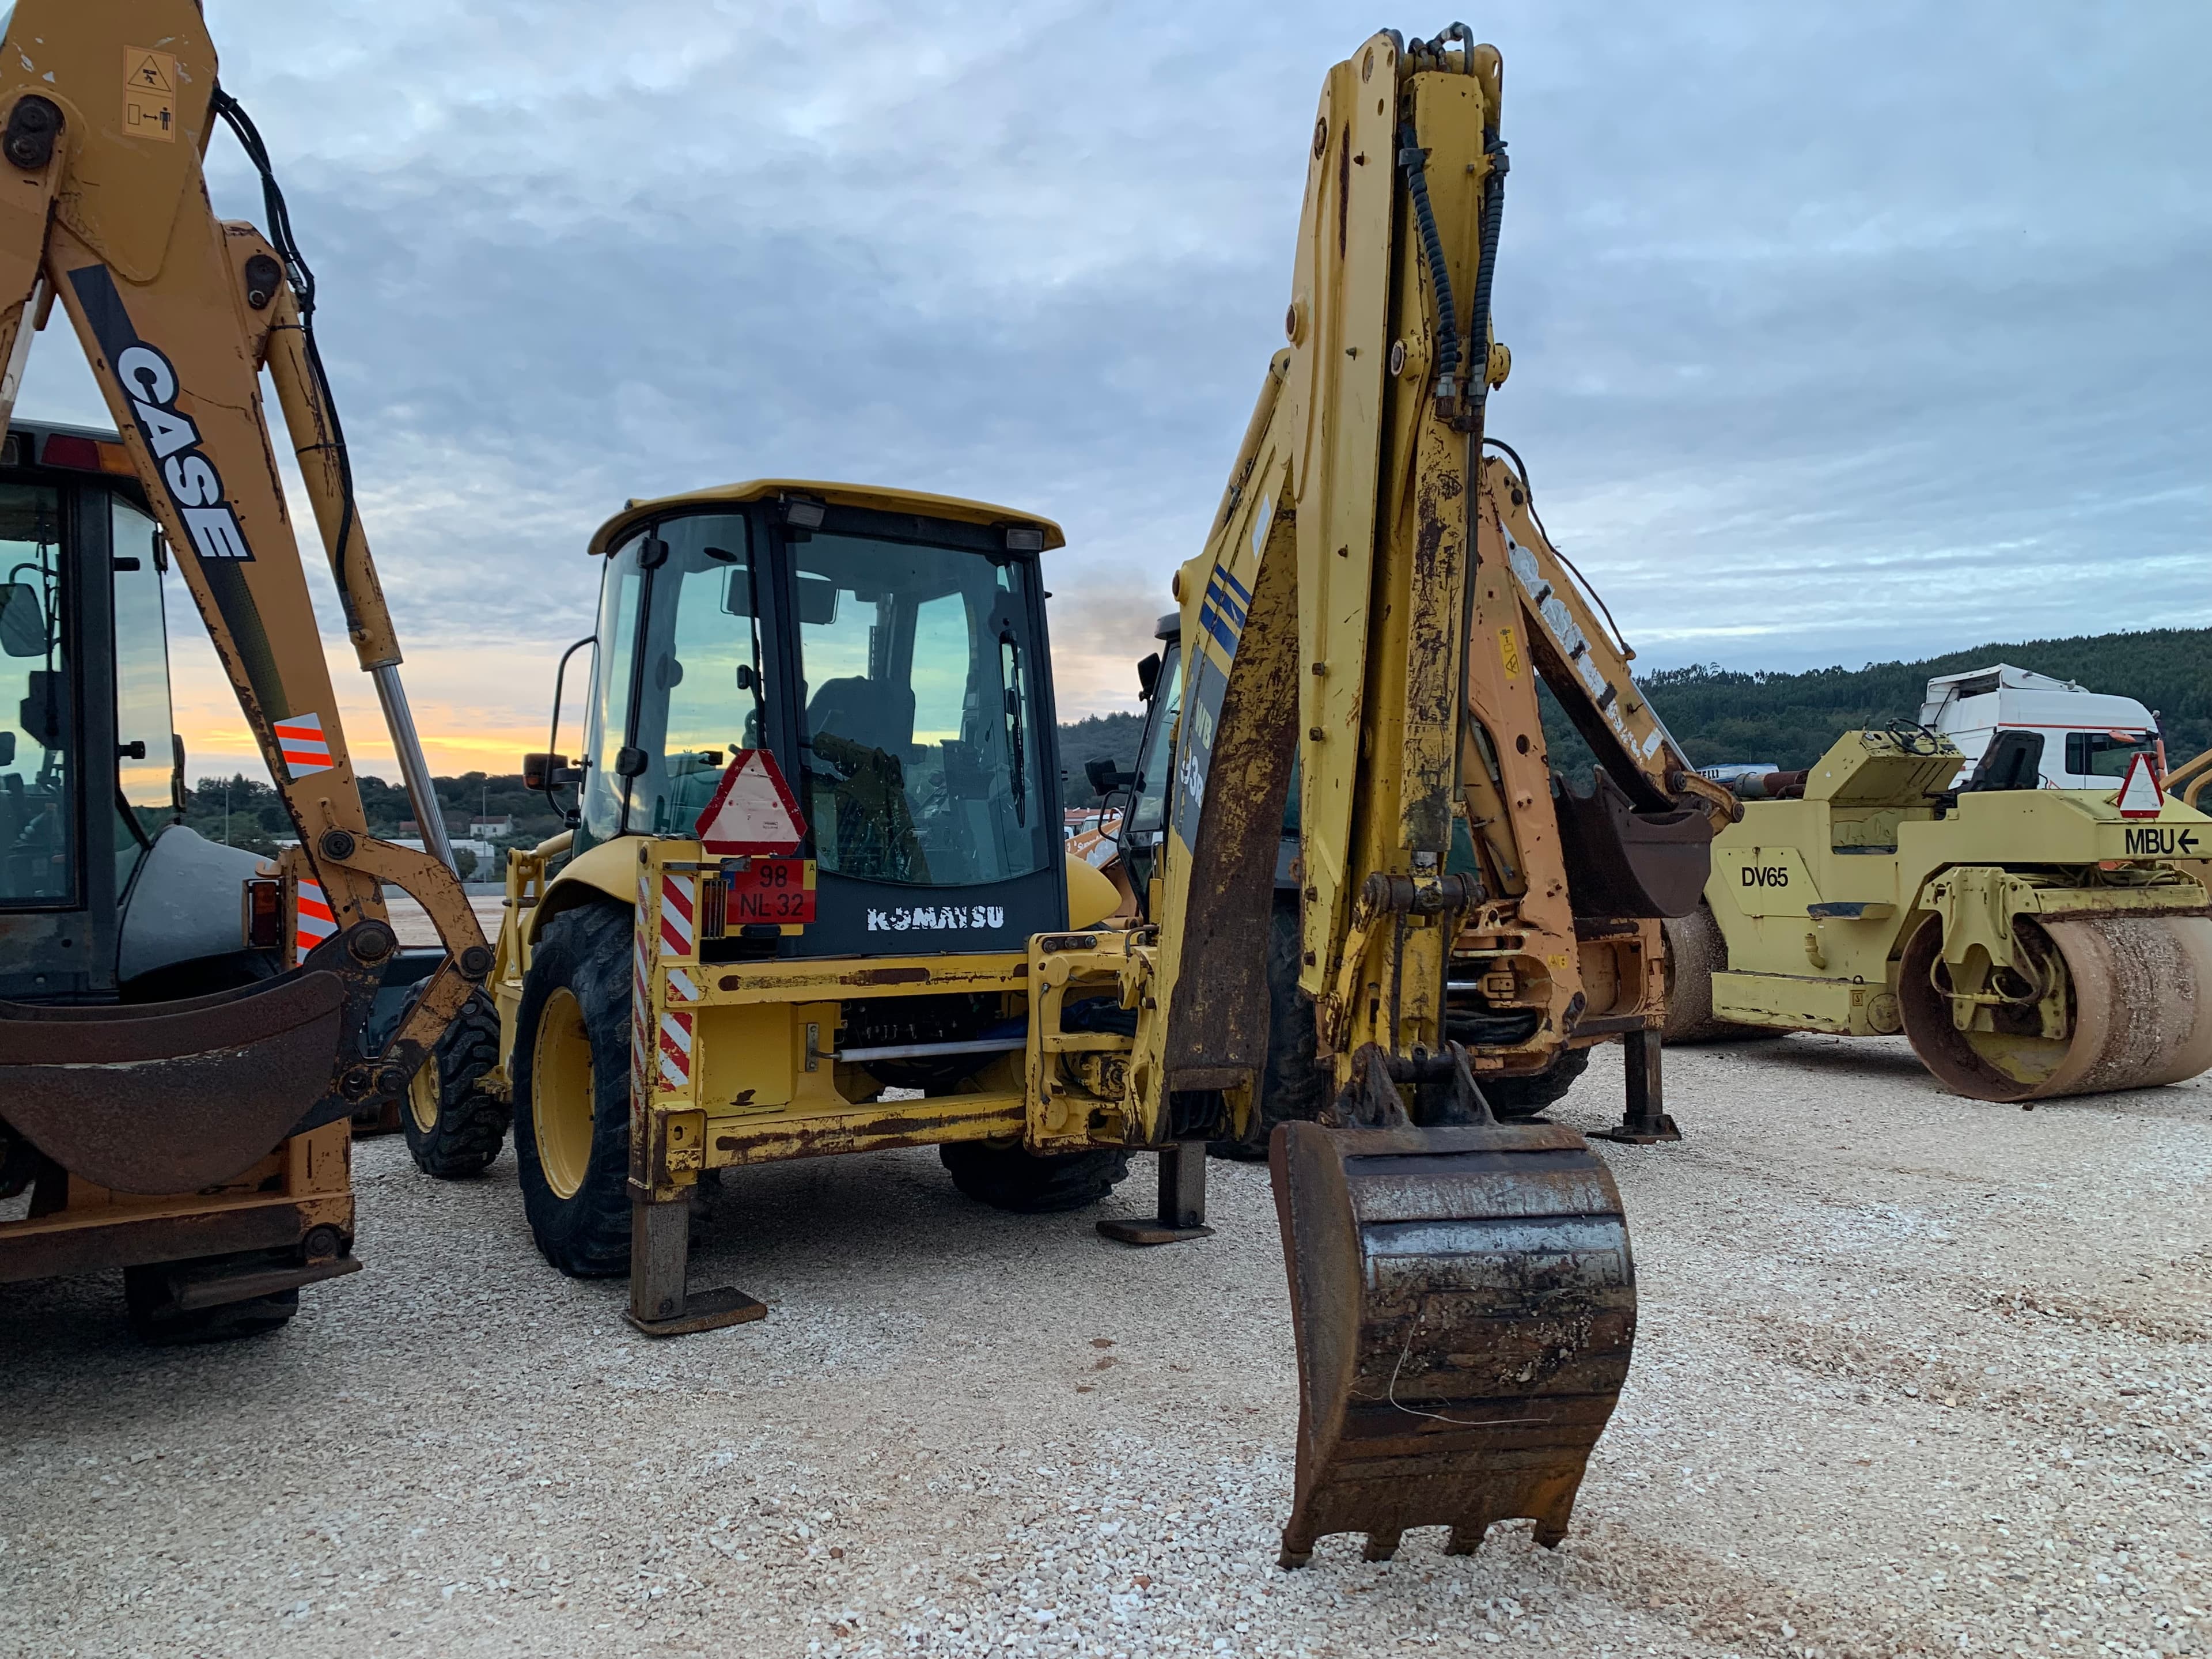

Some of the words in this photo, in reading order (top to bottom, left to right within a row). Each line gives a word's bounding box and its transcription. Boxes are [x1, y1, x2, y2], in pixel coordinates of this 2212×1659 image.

[118, 347, 248, 557] CASE
[1195, 698, 1213, 749] WB
[2126, 828, 2174, 854] MBU
[760, 865, 788, 888] 98
[1742, 866, 1788, 887] DV65
[740, 894, 771, 916] NL
[777, 894, 803, 916] 32
